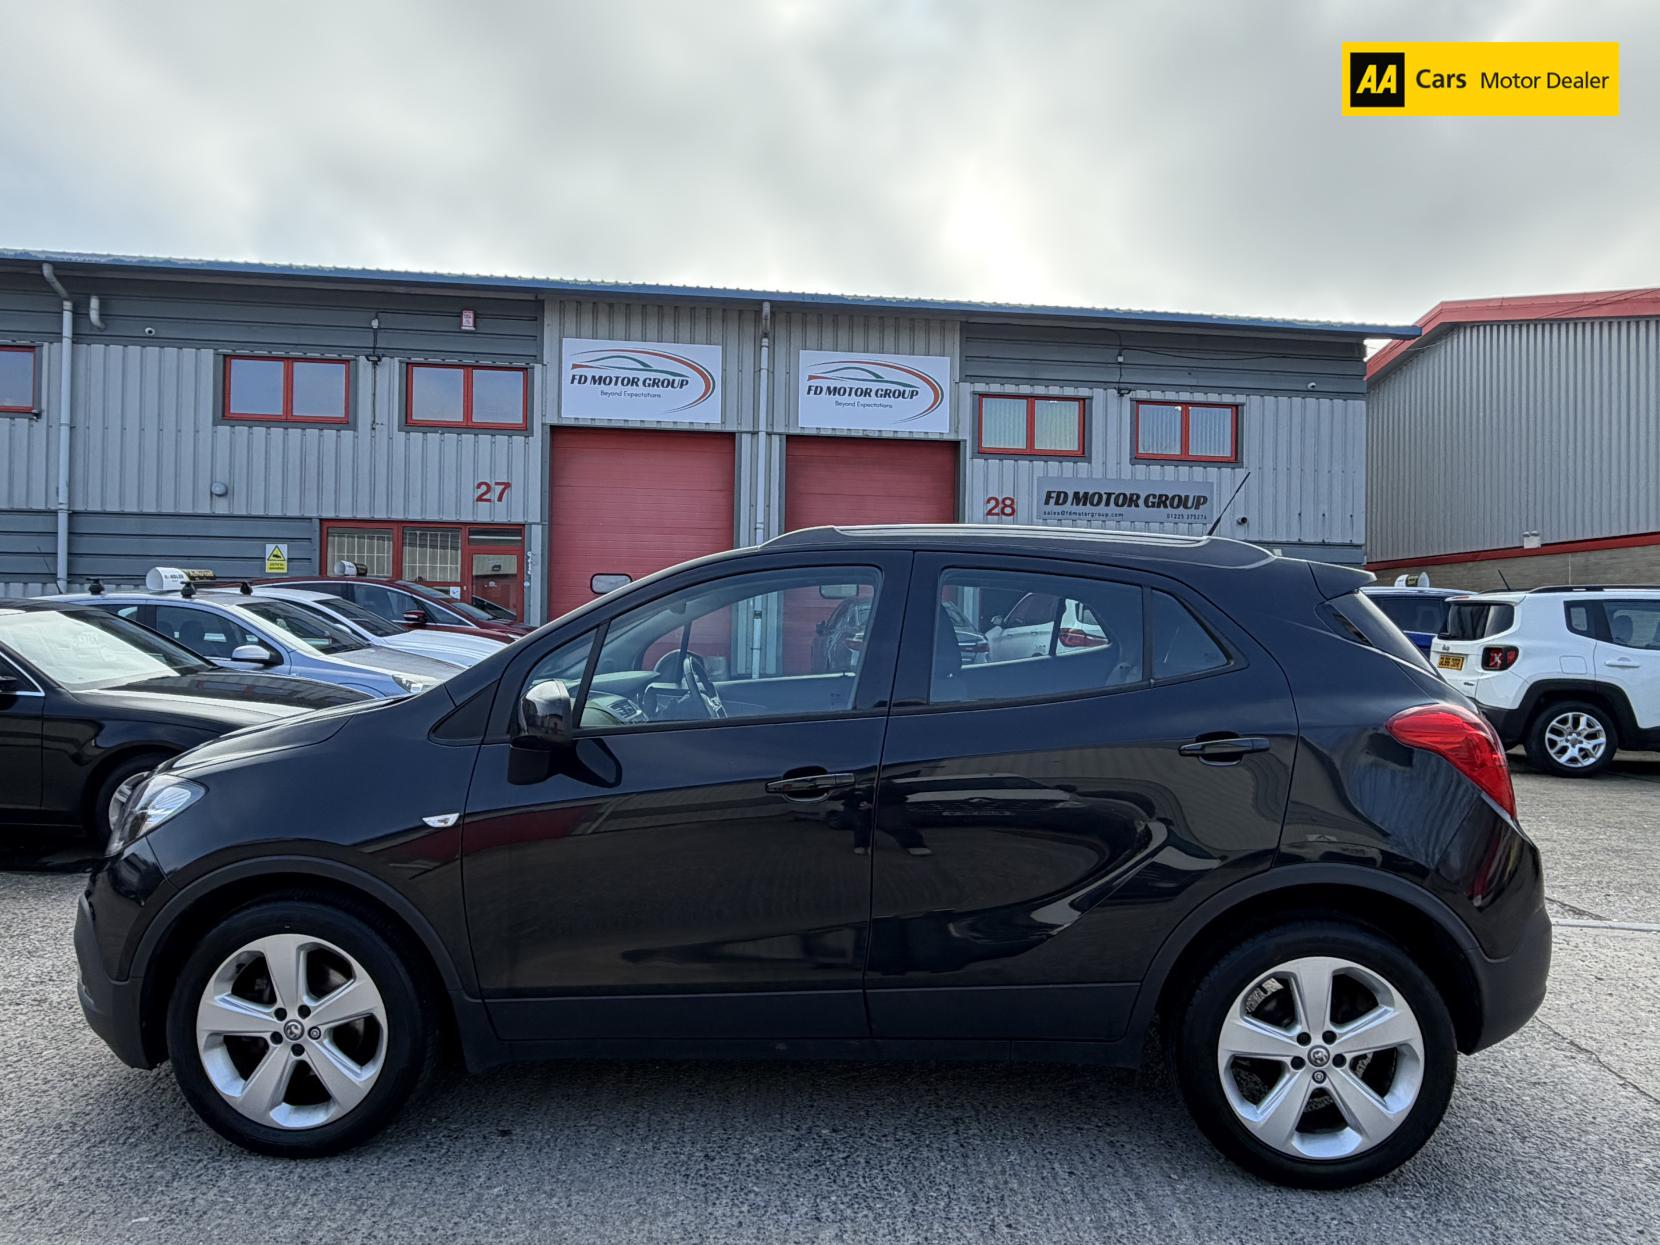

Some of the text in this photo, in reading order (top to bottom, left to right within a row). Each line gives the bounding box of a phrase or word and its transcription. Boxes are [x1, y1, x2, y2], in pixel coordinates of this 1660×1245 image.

[570, 374, 689, 389] FD MOTOR GROUP
[600, 389, 661, 398] Beyond Expectations
[806, 385, 919, 400] FD MOTOR GROUP
[835, 400, 893, 409] Beyond Expectations
[476, 481, 512, 503] 27
[986, 496, 1015, 517] 28
[1044, 490, 1208, 510] FD MOTOR GROUP
